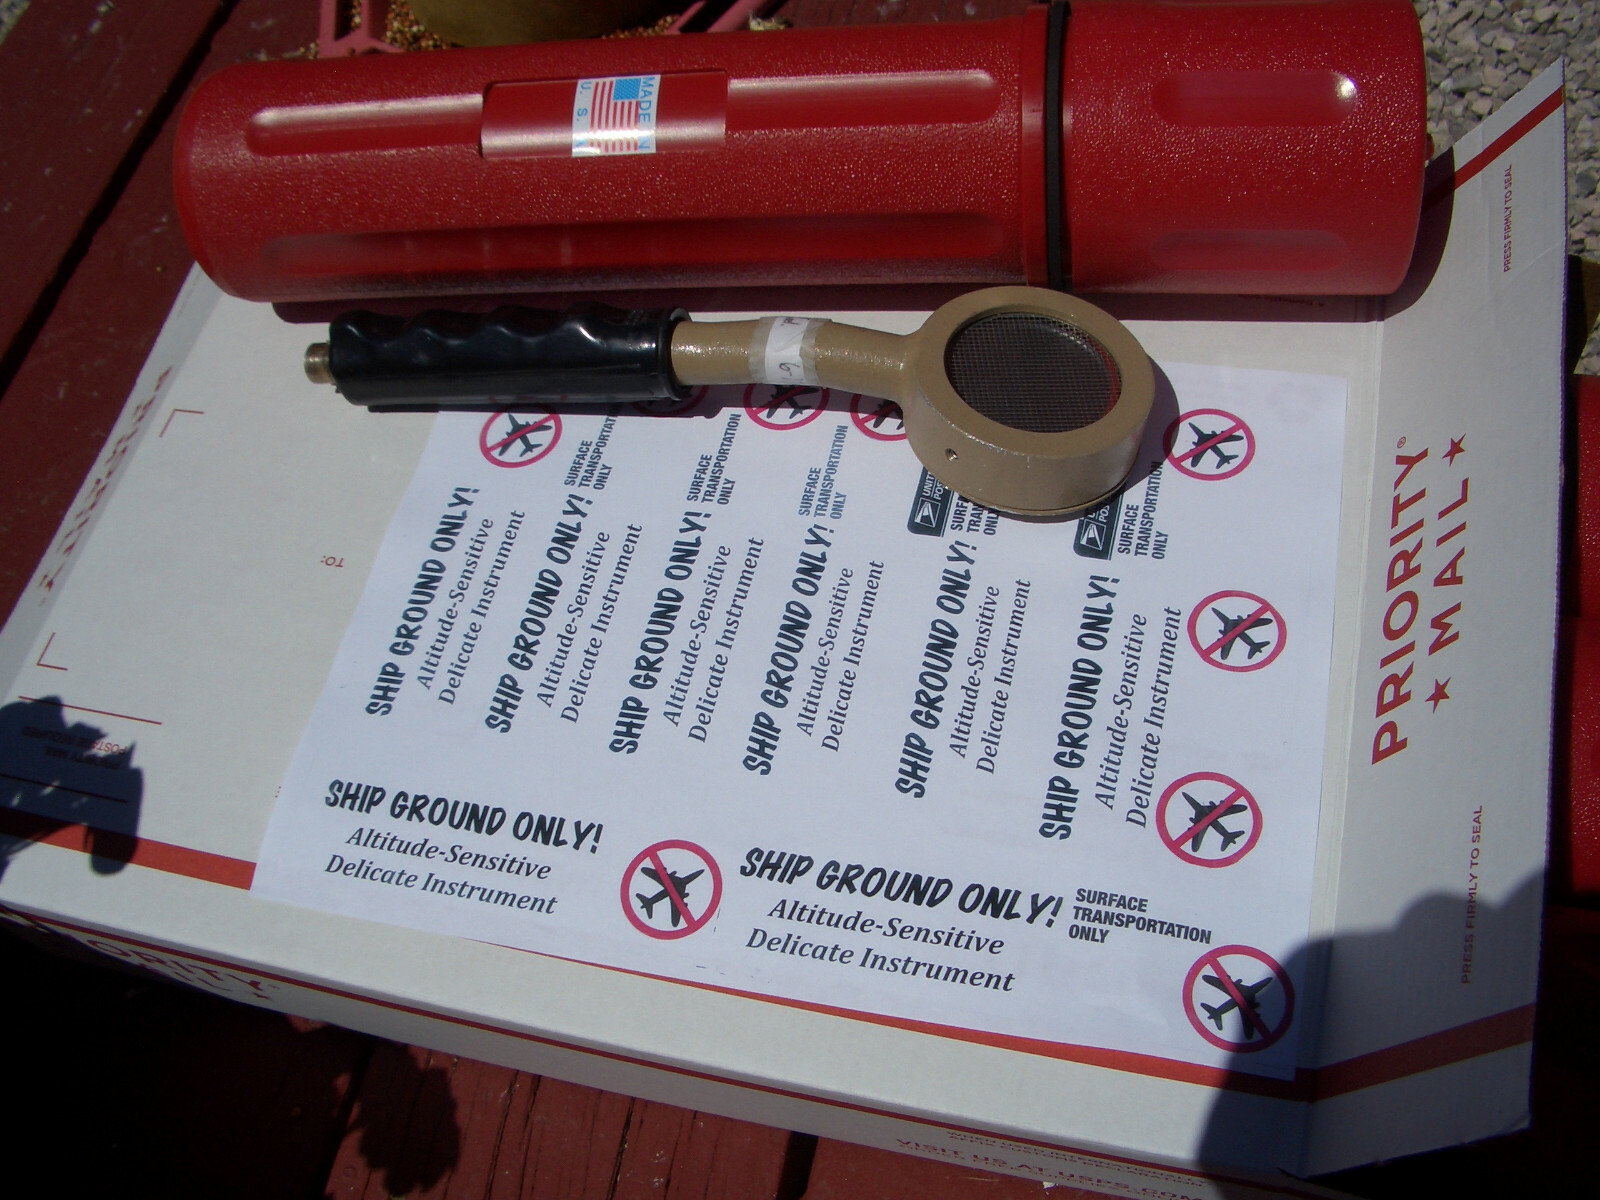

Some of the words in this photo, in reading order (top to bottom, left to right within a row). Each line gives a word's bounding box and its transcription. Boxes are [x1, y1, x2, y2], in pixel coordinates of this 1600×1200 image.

[638, 77, 656, 123] MADE
[1504, 164, 1513, 190] SEAL
[1504, 190, 1513, 206] TO
[1503, 206, 1513, 240] FIRMLY
[1503, 240, 1513, 272] PRESS
[564, 440, 593, 486] SURFACE
[593, 463, 613, 490] ONLY
[686, 454, 712, 501] SURFACE
[701, 413, 742, 503] TRANSPORTATION
[717, 478, 735, 505] ONLY
[798, 467, 821, 516] SURFACE
[814, 425, 848, 517] TRANSPORTATION
[922, 472, 935, 496] UNIT
[830, 492, 847, 519] ONLY
[950, 497, 968, 531] SURF
[983, 512, 1000, 535] ONL
[1117, 504, 1139, 554] SURFACE
[1134, 461, 1164, 556] TRANSPORTATION
[664, 510, 712, 580] ONLY!
[792, 522, 835, 597] ONLY!
[936, 539, 978, 615] ONLY!
[1151, 530, 1168, 560] ONLY
[1428, 476, 1469, 656] MAIL
[365, 661, 405, 716] SHIP
[389, 558, 446, 656] GROUND
[429, 486, 480, 552] ONLY!
[417, 518, 494, 690] Altitude-Sensitive
[438, 622, 482, 705] Delicate
[471, 509, 525, 619] Instrument
[485, 673, 524, 733] SHIP
[507, 567, 563, 671] GROUND
[546, 493, 594, 565] ONLY!
[536, 531, 610, 708] Altitude-Sensitive
[560, 636, 603, 724] Delicate
[590, 523, 643, 634] Instrument
[1077, 574, 1120, 651] ONLY!
[1371, 447, 1429, 765] PRIORITY
[629, 587, 685, 690] GROUND
[663, 545, 731, 727] Altitude-Sensitive
[688, 653, 729, 743] Delicate
[718, 537, 764, 651] Instrument
[761, 600, 812, 709] GROUND
[796, 567, 853, 737] Altitude-Sensitive
[820, 669, 856, 753] Delicate
[843, 560, 884, 667] Instrument
[910, 618, 960, 730] GROUND
[949, 586, 1000, 759] Altitude-Sensitive
[976, 689, 1009, 775] Delicate
[994, 578, 1031, 686] Instrument
[609, 695, 650, 754] SHIP
[743, 711, 782, 776] SHIP
[1053, 658, 1103, 769] GROUND
[1095, 613, 1147, 810] Altitude-Sensitive
[1125, 733, 1161, 828] Delicate
[1143, 606, 1181, 730] Instrument
[894, 731, 934, 799] SHIP
[325, 779, 386, 814] SHIP
[389, 790, 507, 836] GROUND
[512, 811, 604, 854] ONLY!
[1039, 774, 1080, 840] SHIP
[1471, 805, 1483, 843] SEAL
[324, 854, 418, 888] Delicate
[421, 872, 558, 914] Instrument
[345, 826, 552, 879] Altitude-Sensitive
[1470, 847, 1480, 869] TO
[739, 847, 814, 886] SHIP
[816, 864, 954, 910] GROUND
[957, 883, 1064, 928] ONLY!
[1074, 888, 1149, 913] SURFACE
[1465, 872, 1478, 929] FIRMLY
[767, 898, 1005, 955] Altitude-Sensitive
[1068, 924, 1111, 945] ONLY
[1071, 905, 1213, 945] TRANSPORTATION
[746, 928, 853, 965] Delicate
[859, 947, 1015, 991] Instrument
[1461, 934, 1475, 984] PRESS
